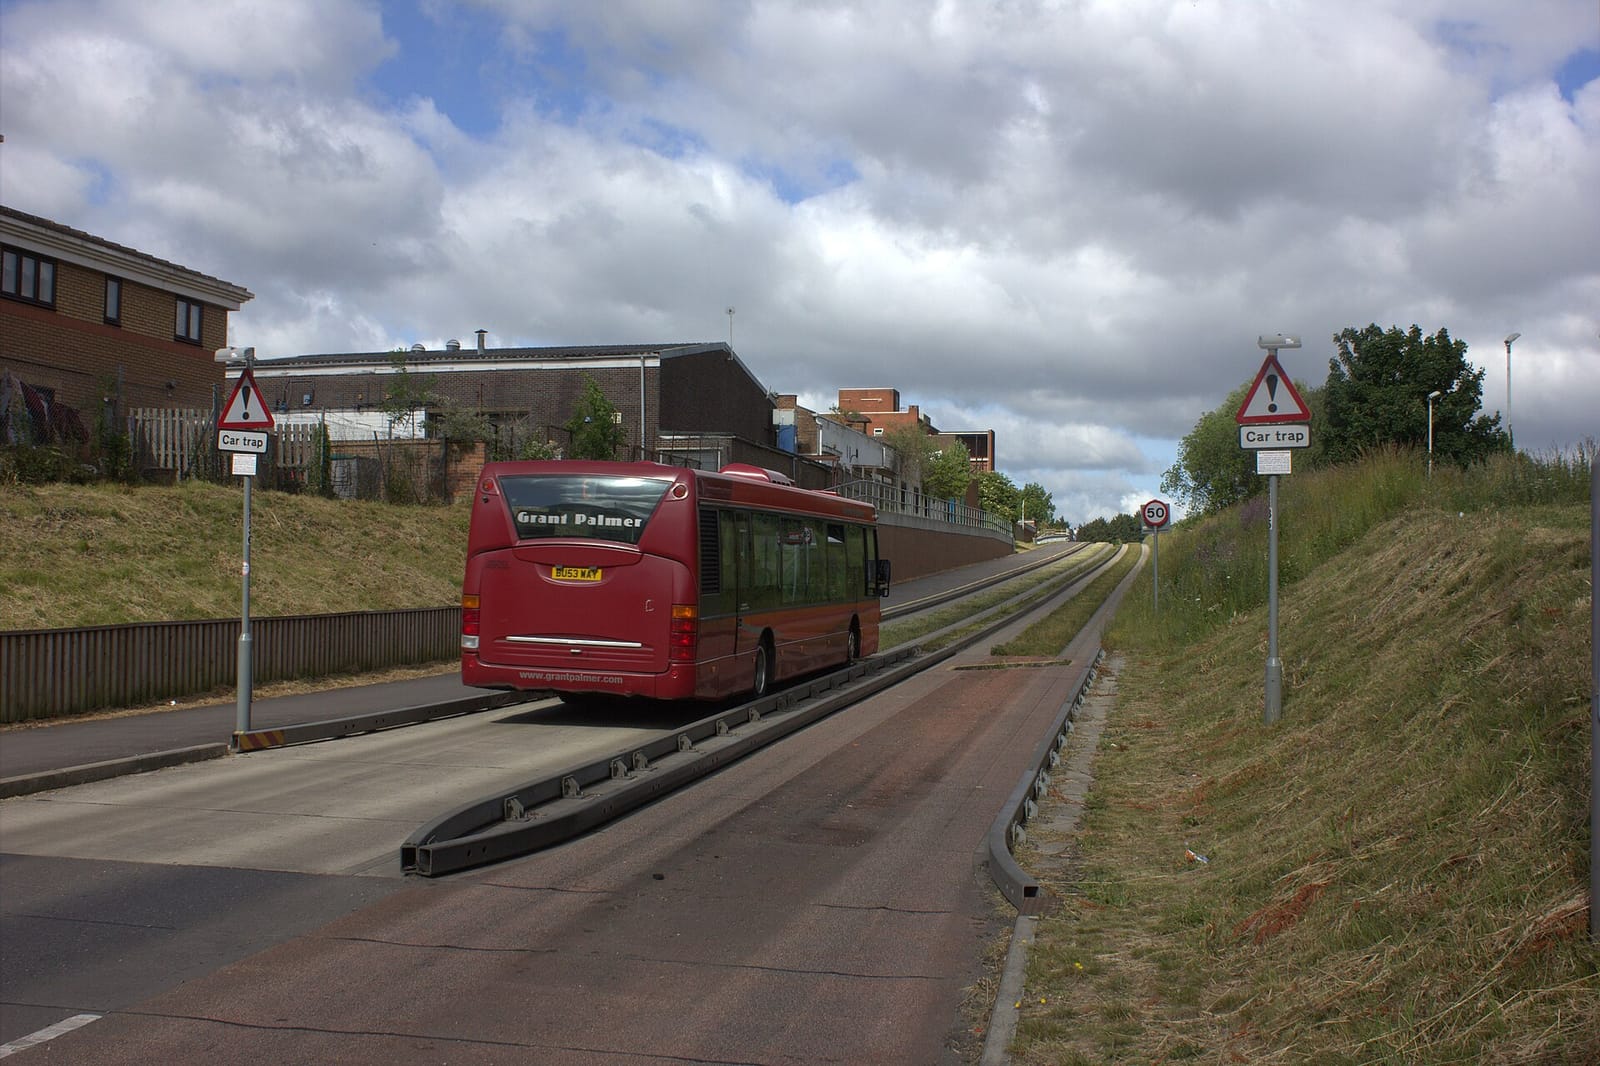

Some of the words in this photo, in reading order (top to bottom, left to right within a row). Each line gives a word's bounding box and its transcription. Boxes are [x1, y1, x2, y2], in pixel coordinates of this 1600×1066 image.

[222, 434, 239, 446] Car
[243, 436, 263, 449] trap
[1246, 431, 1270, 443] Car
[1275, 431, 1304, 443] trap
[1147, 507, 1165, 518] 50
[517, 511, 568, 524] Grant
[574, 513, 643, 527] Palmer
[555, 567, 578, 578] BU53
[580, 568, 598, 579] WAY
[519, 671, 623, 684] www.grantpalmer.com
